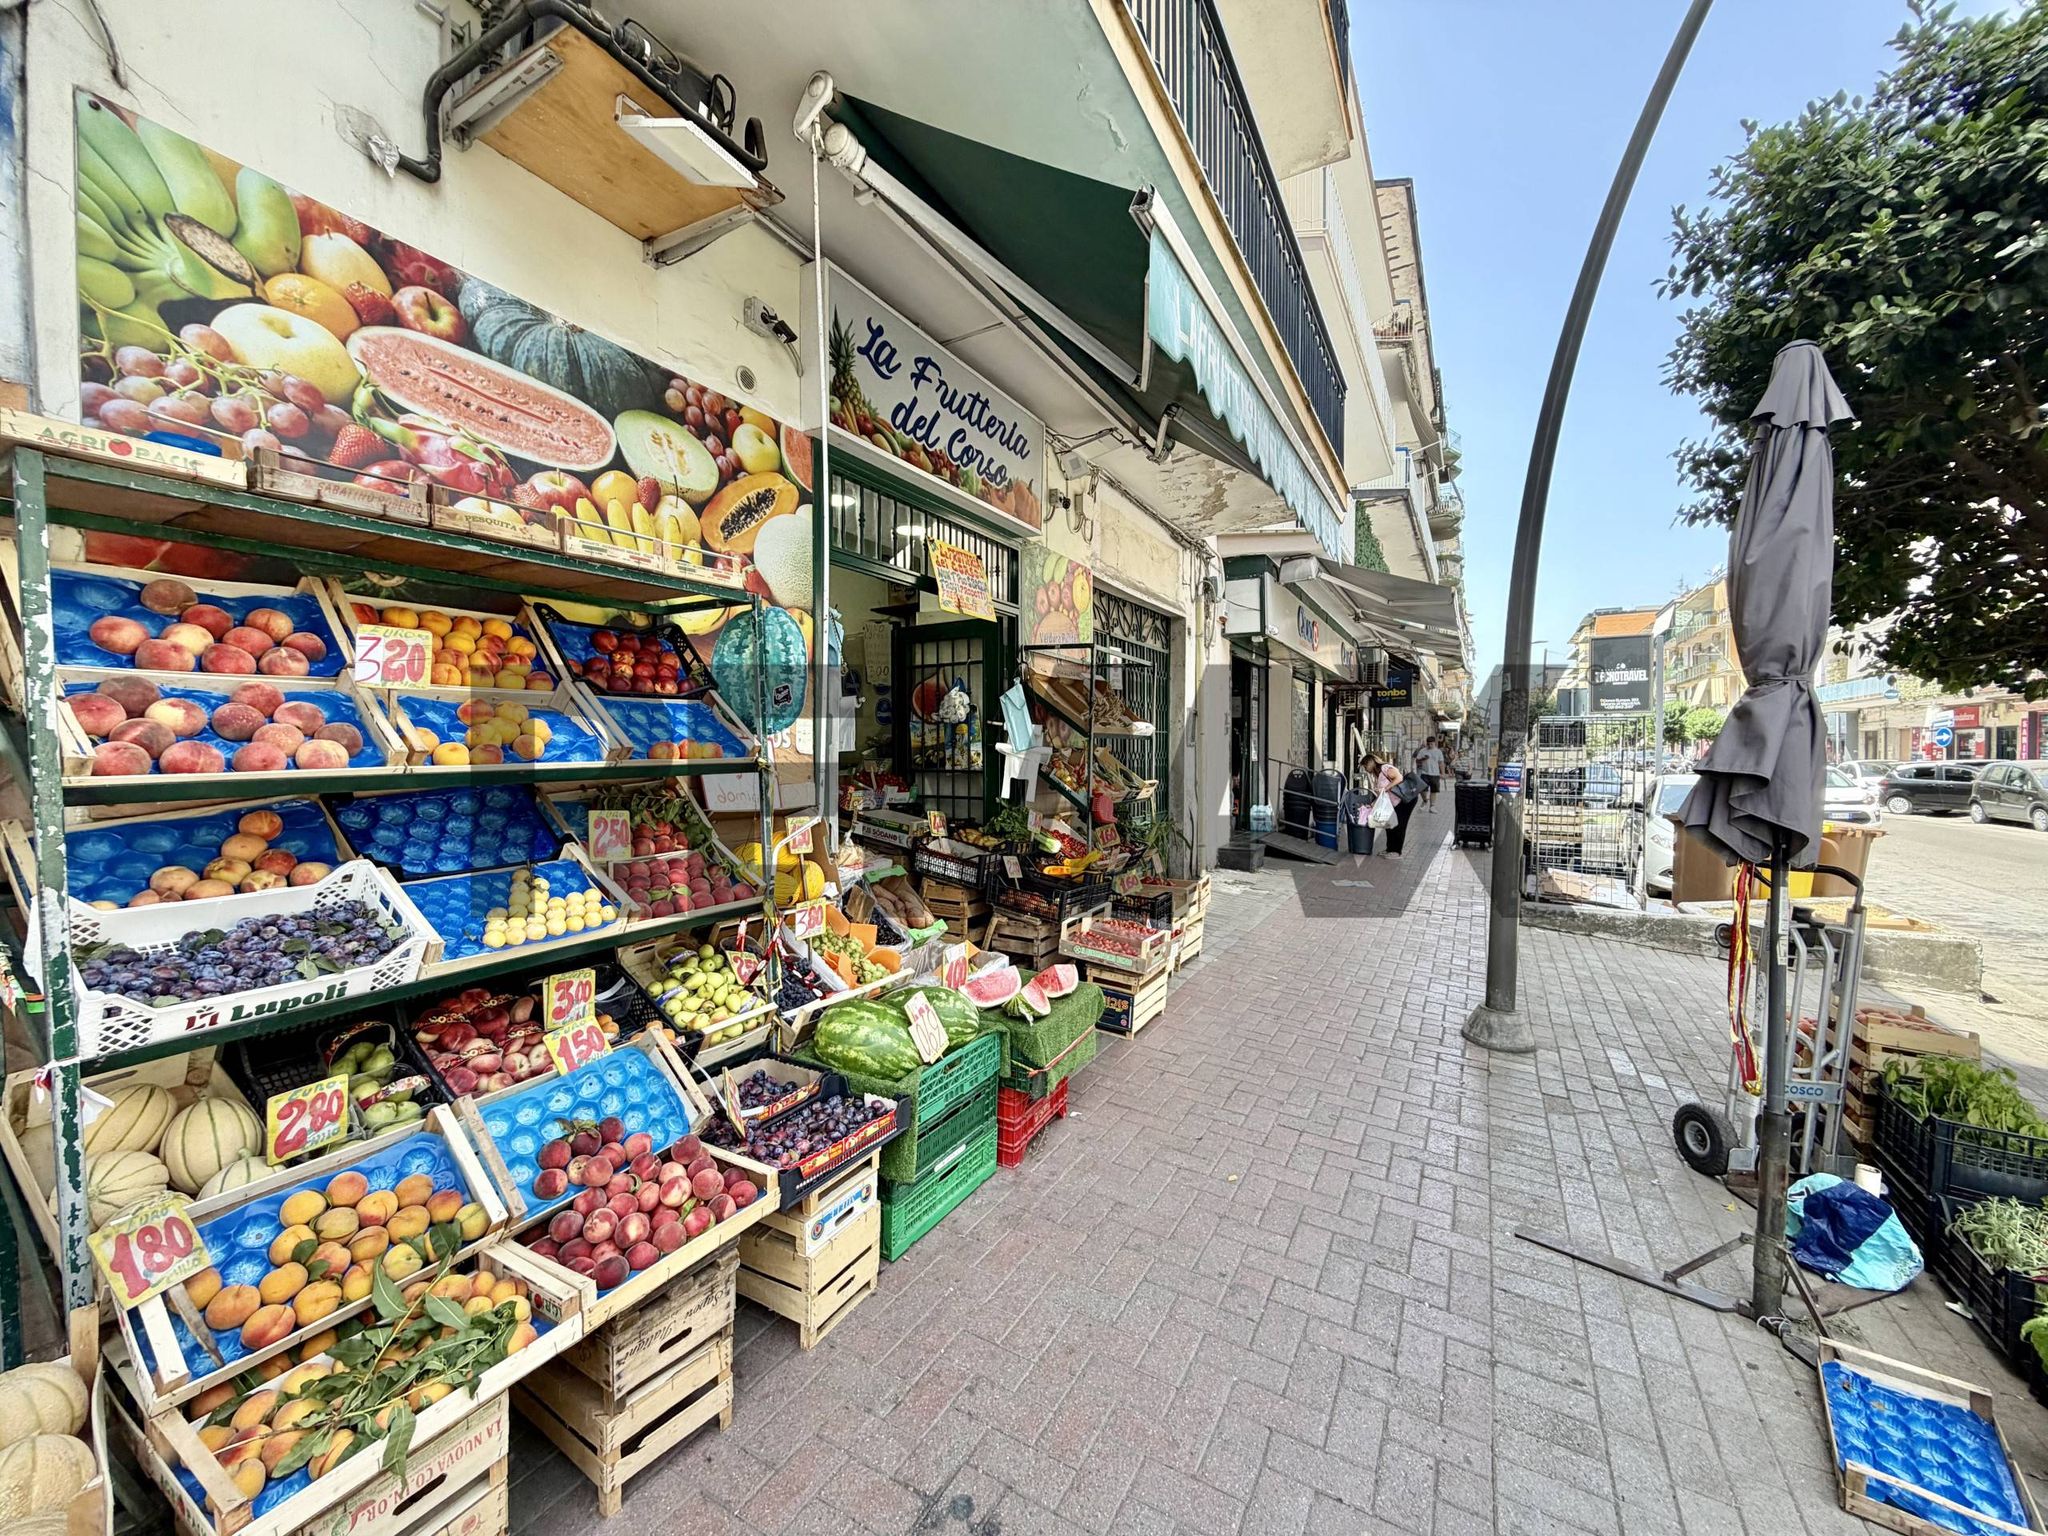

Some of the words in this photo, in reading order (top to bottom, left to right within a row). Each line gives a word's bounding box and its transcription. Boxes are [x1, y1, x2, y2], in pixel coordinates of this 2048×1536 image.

[857, 317, 902, 380] La
[910, 356, 1031, 460] Frutteria
[41, 426, 106, 452] AGRI
[890, 396, 941, 449] del
[947, 428, 1009, 485] Corso
[464, 513, 518, 531] PESQUITA
[355, 636, 426, 683] 320
[593, 816, 630, 858] 250
[229, 980, 350, 1022] Lupoli
[551, 979, 592, 1021] 300
[556, 1025, 606, 1072] 150
[1784, 1084, 1824, 1097] COSCO
[273, 1089, 345, 1159] 280
[109, 1216, 194, 1299] 180
[437, 1435, 483, 1472] NUOVA
